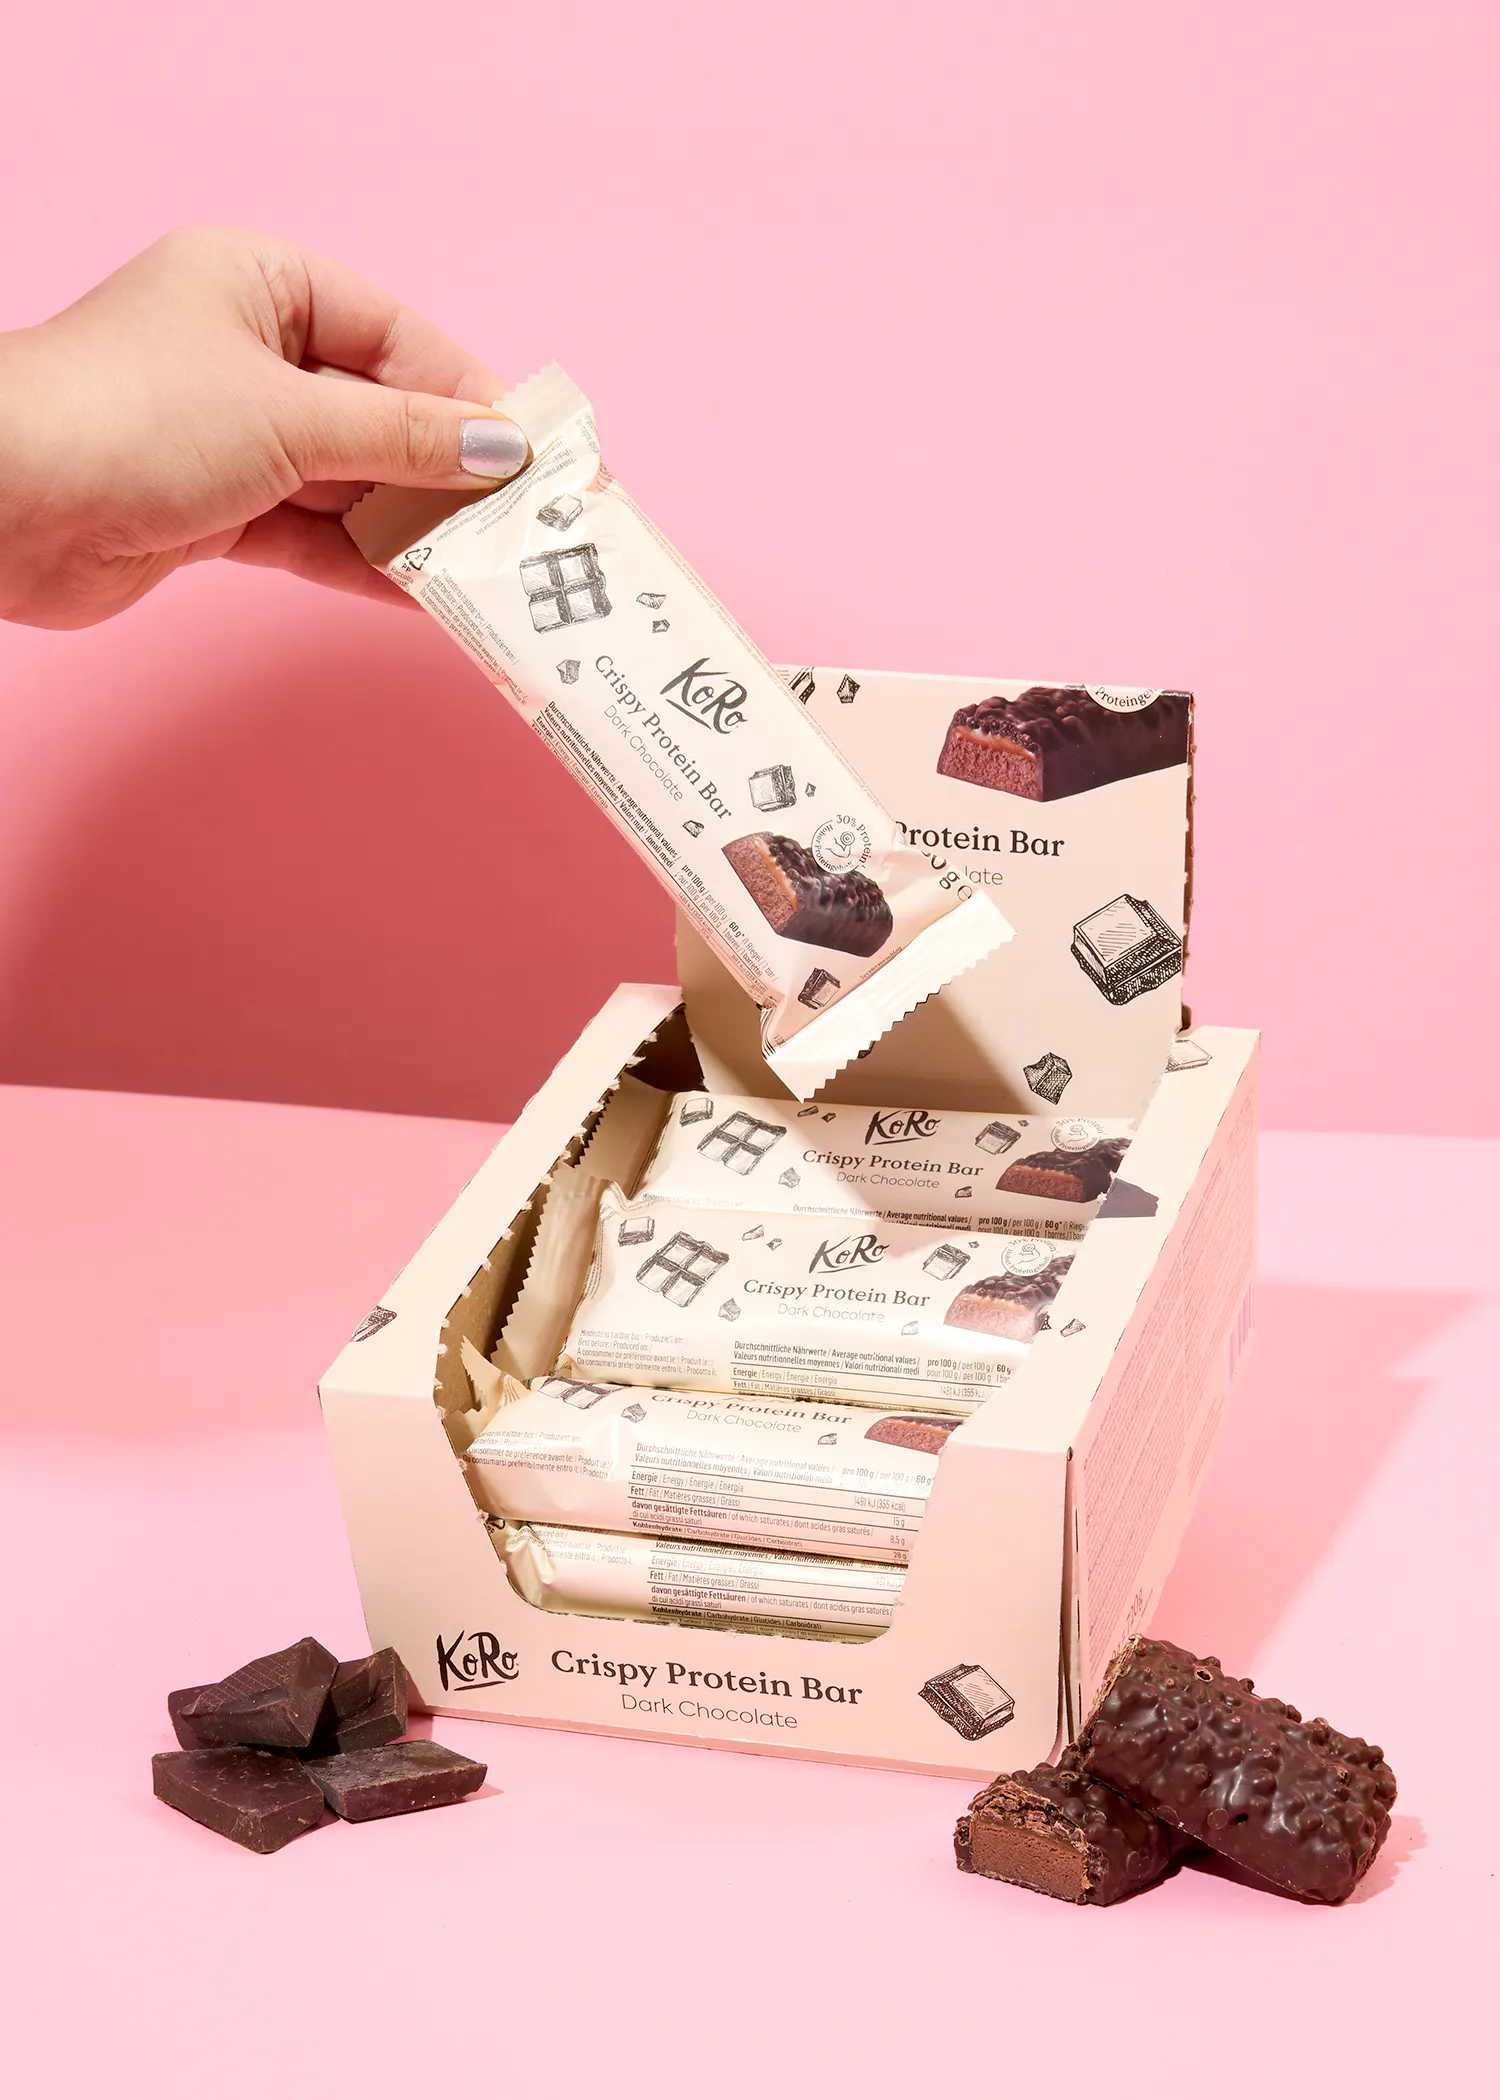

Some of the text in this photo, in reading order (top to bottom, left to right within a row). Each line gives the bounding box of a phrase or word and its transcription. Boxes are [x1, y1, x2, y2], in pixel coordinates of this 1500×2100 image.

[456, 605, 478, 630] Produced
[660, 657, 748, 734] KoRo
[595, 655, 732, 820] Crispy Protein Bar
[603, 704, 684, 802] Dark Chocolate
[542, 708, 562, 730] Valeurs
[559, 729, 596, 772] nutritionnelles
[592, 771, 618, 801] moyennes
[619, 802, 635, 821] Valori
[659, 851, 673, 867] medi
[548, 701, 678, 857] Durchschnittliche Nährwerte Average nutritional values
[1009, 830, 1065, 857] Bar
[681, 864, 693, 876] pro
[691, 875, 702, 887] 100
[729, 922, 738, 932] 60
[865, 1109, 942, 1145] KoRo
[802, 1150, 984, 1175] Crispy Protein Bar
[837, 1172, 940, 1188] Dark Chocolate
[887, 1210, 912, 1220] Average
[913, 1212, 946, 1222] nutritional
[948, 1213, 968, 1223] values
[978, 1217, 990, 1225] pro
[991, 1217, 1002, 1225] 100
[1024, 1219, 1034, 1227] 100
[1045, 1220, 1053, 1228] 60
[808, 1234, 890, 1274] KoRo
[744, 1279, 931, 1307] Crispy Protein Bar
[777, 1303, 885, 1323] Dark Chocolate
[612, 1341, 639, 1350] Produced
[734, 1341, 792, 1353] Durchschnittliche
[793, 1346, 827, 1356] Nährwerte
[832, 1349, 858, 1360] Average
[895, 1356, 916, 1365] values
[734, 1351, 920, 1375] Valeurs nutritionnelles moyennes Valori nutrizionali medi
[927, 1358, 1006, 1373] pro 100 per 100 60
[733, 1368, 838, 1385] Energie Energy Énergie Energia
[963, 1372, 986, 1381] per 100
[791, 1387, 813, 1395] grasses
[651, 1394, 853, 1424] Crispy Protein Bar
[686, 1410, 802, 1433] Dark Chocolate
[636, 1442, 698, 1458] Durchschnittliche
[635, 1453, 774, 1477] Valeurs nutritionnelles moyennes Valori
[632, 1471, 744, 1493] Energie Energy Énergie Energia
[630, 1486, 740, 1507] Fett Fat Matières grasses Grassi
[632, 1500, 870, 1537] davon gesättigte Fettsäuren which saturates dont acides gras saturés
[632, 1521, 682, 1533] Kohlenhydrate
[665, 1515, 684, 1524] grassi
[893, 1516, 900, 1526] 15
[651, 1555, 678, 1567] Energie
[655, 1541, 768, 1560] Valeurs nutritionnelles moyennes
[650, 1570, 760, 1589] Fett Fat Matières grasses Grassi
[651, 1585, 672, 1595] davon
[673, 1588, 707, 1600] gesättigte
[709, 1590, 746, 1603] Fettsäuren
[758, 1596, 778, 1606] which
[779, 1599, 809, 1609] saturates
[813, 1601, 828, 1611] dont
[829, 1603, 850, 1612] acides
[851, 1605, 865, 1614] gras
[866, 1606, 889, 1616] saturés
[684, 1599, 703, 1607] grassi
[652, 1606, 702, 1618] Kohlenhydrate
[706, 1612, 750, 1623] Carbohydrate
[753, 1616, 781, 1626] Glucides
[785, 1619, 822, 1630] Carboidrati
[436, 1630, 520, 1691] KoRo
[551, 1649, 864, 1705] Crispy Protein Bar
[621, 1693, 798, 1730] Dark Chocolate
